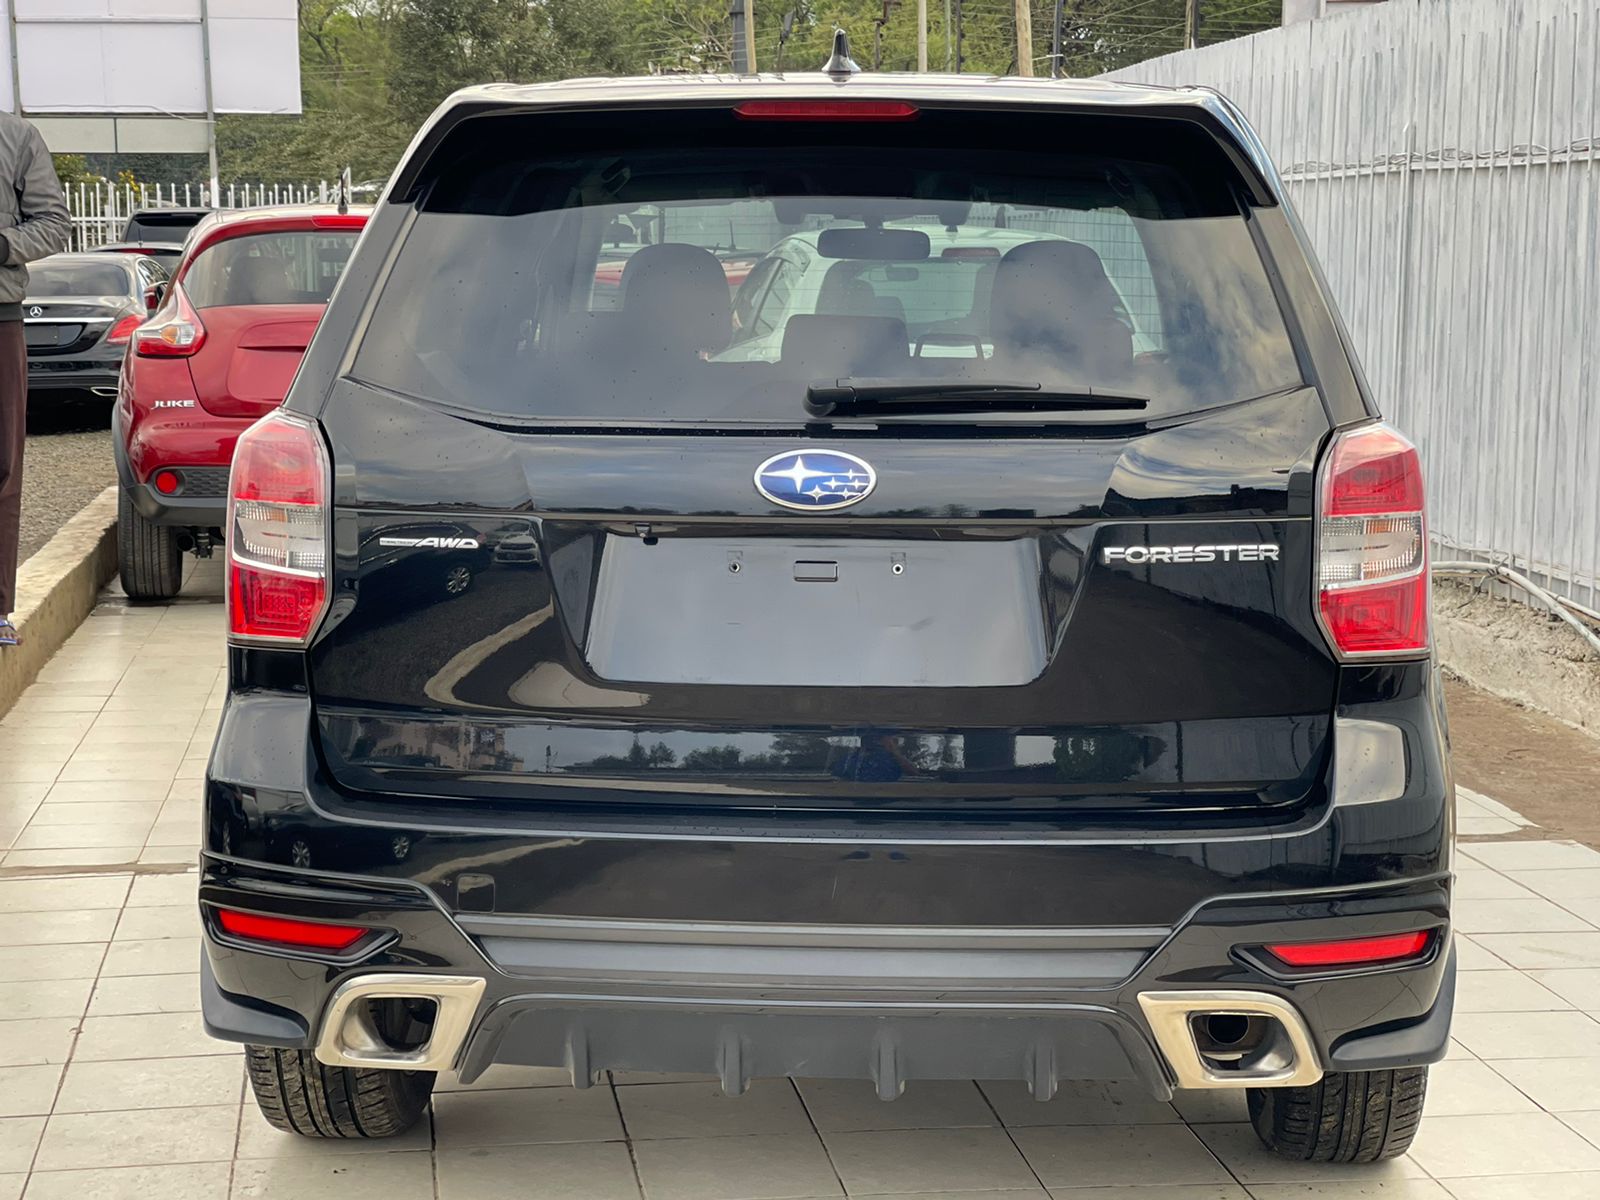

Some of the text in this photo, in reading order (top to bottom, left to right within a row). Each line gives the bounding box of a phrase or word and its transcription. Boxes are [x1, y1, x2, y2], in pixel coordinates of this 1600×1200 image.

[151, 400, 195, 410] JUKE
[415, 537, 479, 549] AWD
[1103, 544, 1280, 564] FORESTER
